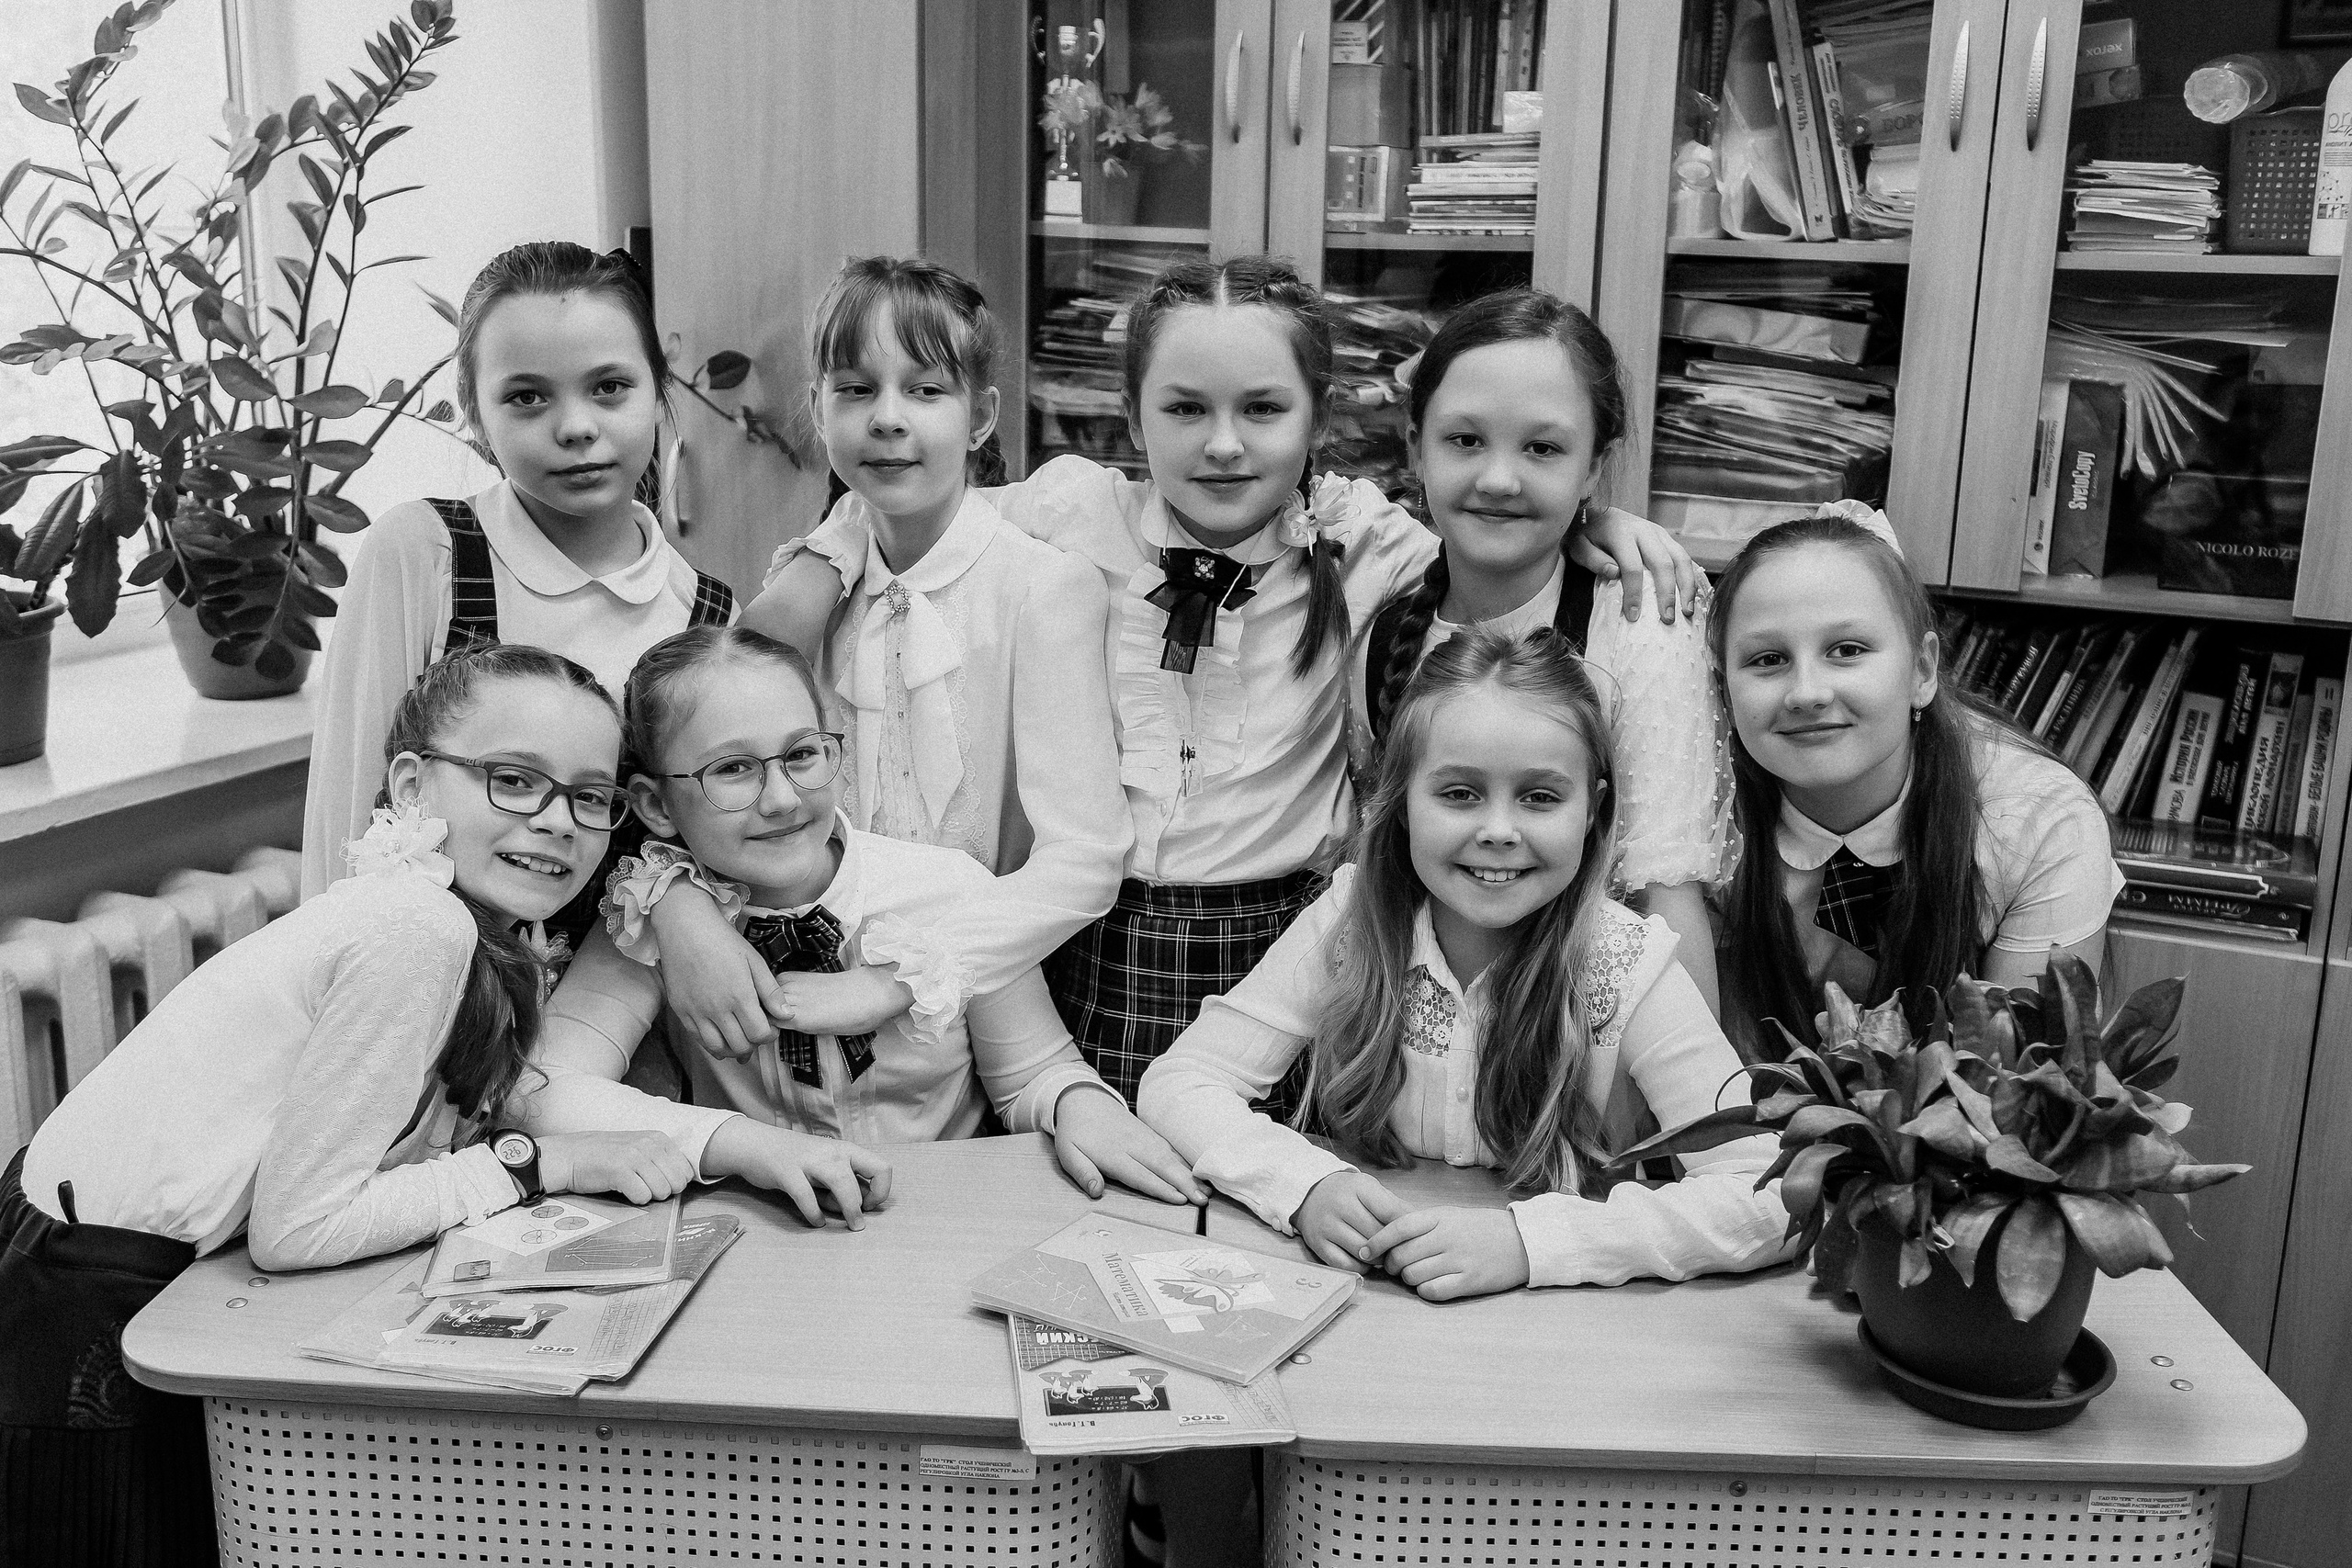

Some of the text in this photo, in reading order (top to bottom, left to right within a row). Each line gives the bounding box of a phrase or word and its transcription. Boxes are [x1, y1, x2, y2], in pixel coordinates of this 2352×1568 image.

[2086, 42, 2122, 57] xerox
[2068, 450, 2096, 510] SvetoCopy
[2197, 541, 2254, 557] NICOLO
[2168, 789, 2186, 820] ИМОВА
[2245, 737, 2270, 829] ЦИКЛОПЕДИЯ
[1102, 1252, 1148, 1316] Математика
